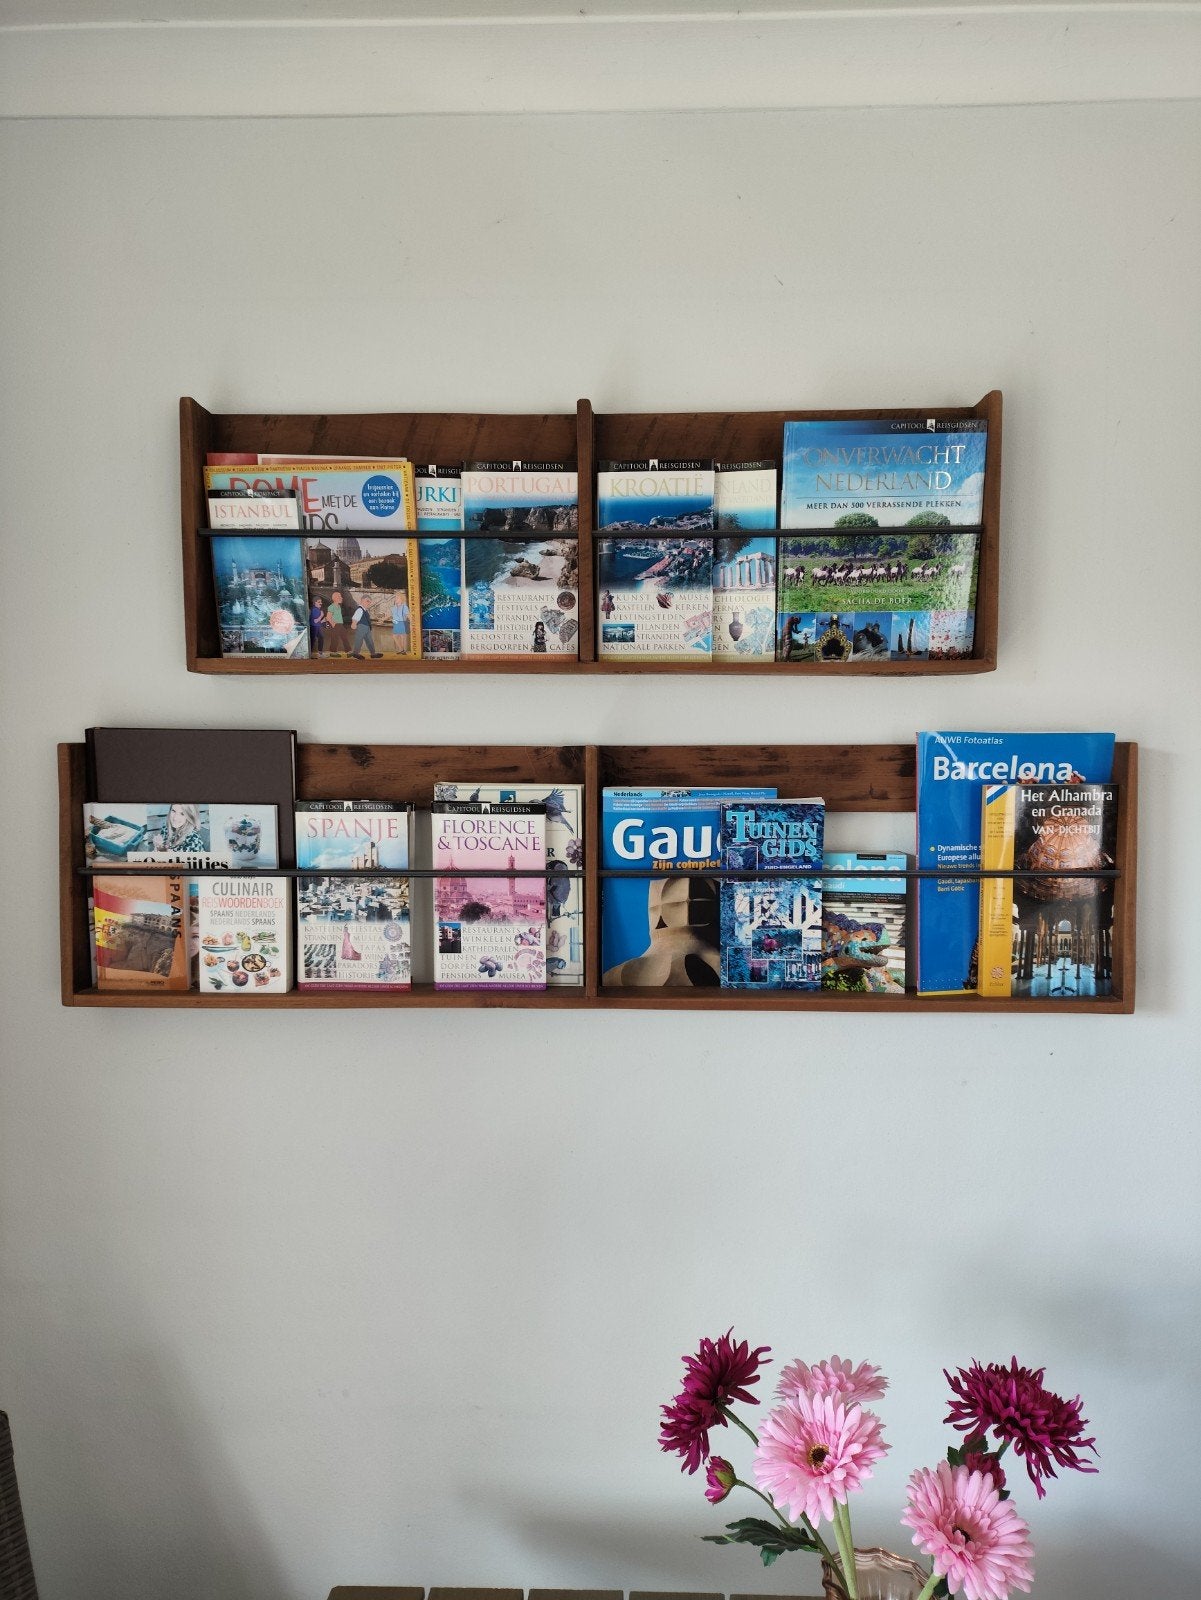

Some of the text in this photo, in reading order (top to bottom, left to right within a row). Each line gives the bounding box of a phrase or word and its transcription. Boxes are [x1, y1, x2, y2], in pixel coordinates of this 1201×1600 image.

[802, 445, 966, 467] ONVERWACHT
[720, 462, 762, 470] REISGIDSEN
[467, 476, 576, 494] PORTUGAL
[609, 473, 703, 497] KROATIË
[816, 471, 952, 492] NEDERLAND
[322, 495, 358, 508] MET DE
[807, 502, 828, 510] MEER
[925, 500, 962, 508] PLEKKEN
[215, 504, 293, 519] ISTANBUL
[497, 594, 555, 602] RESTAURANTS
[496, 614, 538, 622] STRANDEN
[612, 613, 685, 621] VESTINGSTEDEN
[636, 623, 680, 631] EILANDEN
[470, 633, 524, 641] KLOOSTERS
[636, 633, 680, 641] STRANDEN
[470, 643, 528, 651] BERGDORPEN
[603, 643, 685, 651] NATIONALE PARKEN
[934, 736, 1004, 745] ANWB Fotoatlas
[933, 755, 1073, 781] Barcelona
[1021, 789, 1113, 802] Het Alhambra
[1031, 804, 1102, 817] en Granada
[307, 817, 399, 842] SPANJE
[443, 819, 536, 835] FLORENCE
[1032, 824, 1102, 835] VAN DICHTBIJ
[437, 835, 541, 851] & TOSCANE
[612, 818, 721, 860] Gau
[761, 839, 817, 858] GIDS
[937, 844, 978, 854] Dynamische
[937, 854, 968, 863] Europese
[652, 860, 673, 871] Zijn
[212, 882, 274, 897] CULINAIR
[201, 897, 284, 909] REISWOORDENBOEK
[209, 910, 276, 918] SPAANS NEDERLANDS
[209, 918, 276, 926] NEDERLANDS SPAANS
[462, 926, 521, 934] RESTAURANTS
[462, 935, 512, 943] WINKELEN
[338, 962, 378, 970] PARADORS
